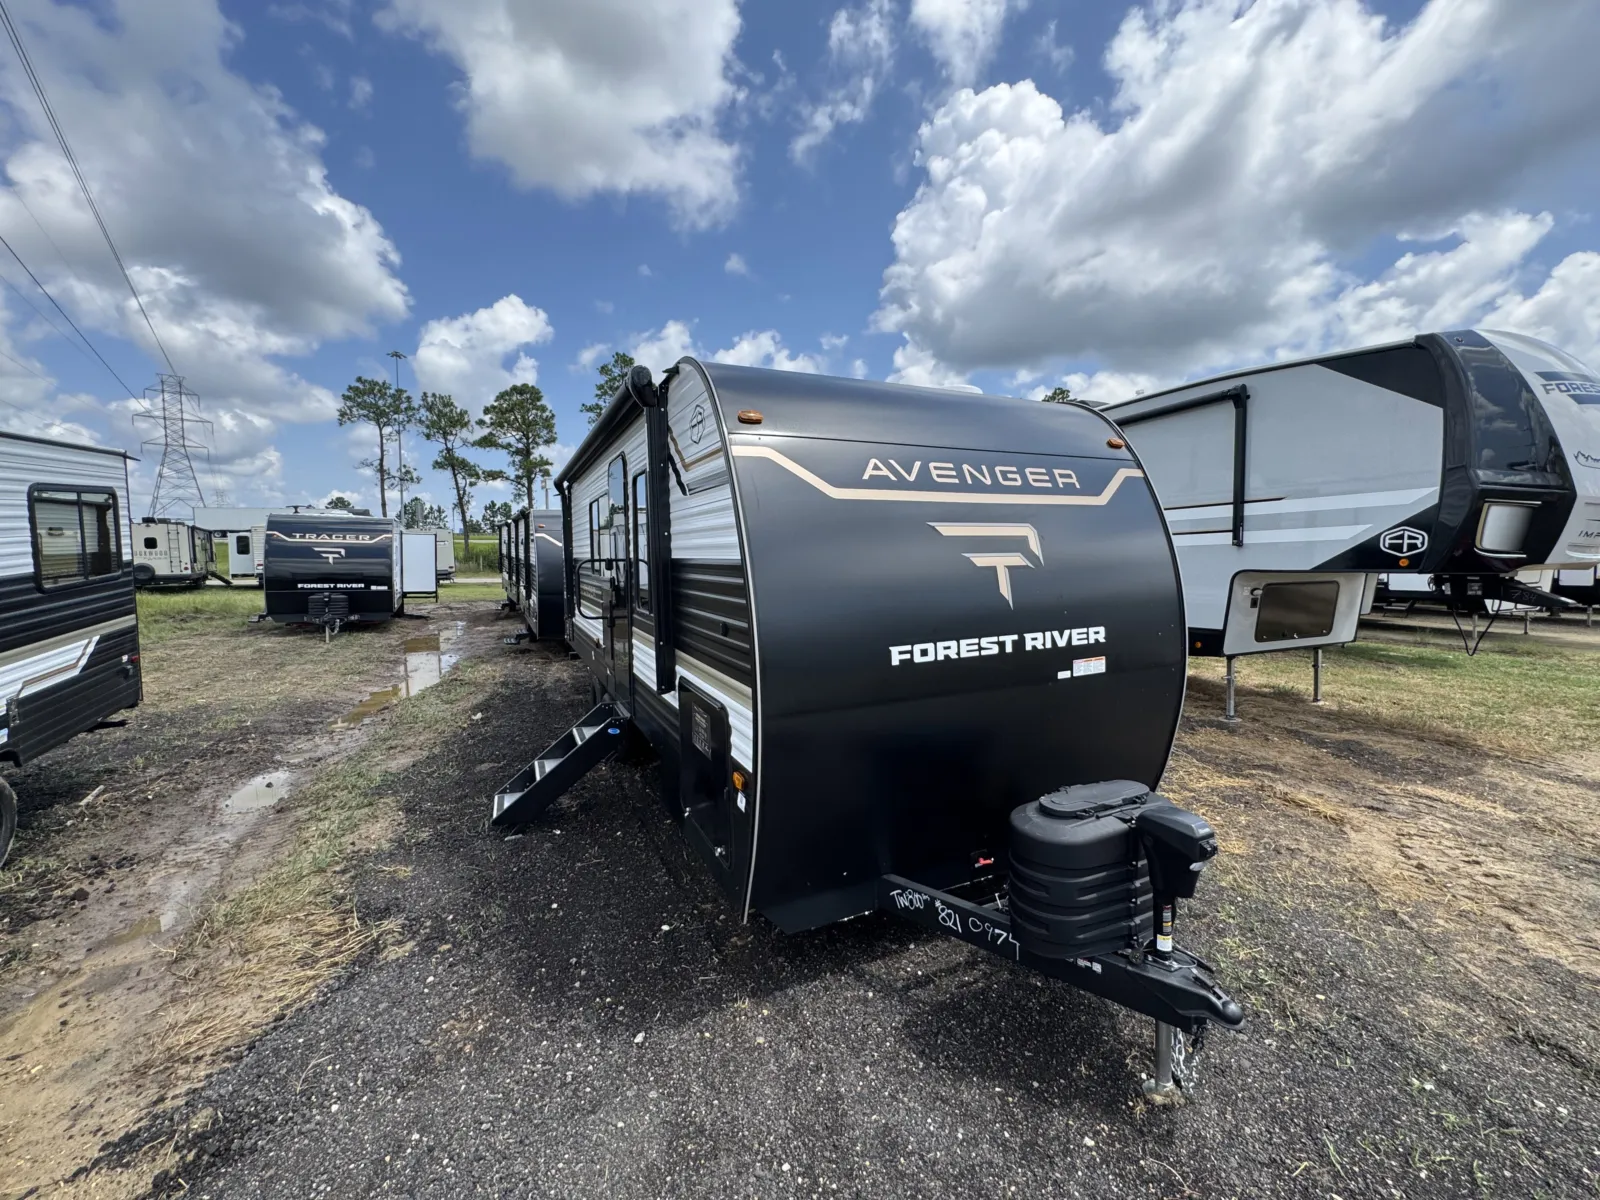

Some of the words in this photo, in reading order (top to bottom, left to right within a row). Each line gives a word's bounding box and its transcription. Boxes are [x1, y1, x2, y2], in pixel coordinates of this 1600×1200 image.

[862, 458, 1081, 489] AVENGER
[292, 533, 370, 541] TRACER
[889, 634, 1019, 666] FOREST
[1023, 626, 1106, 651] RIVER
